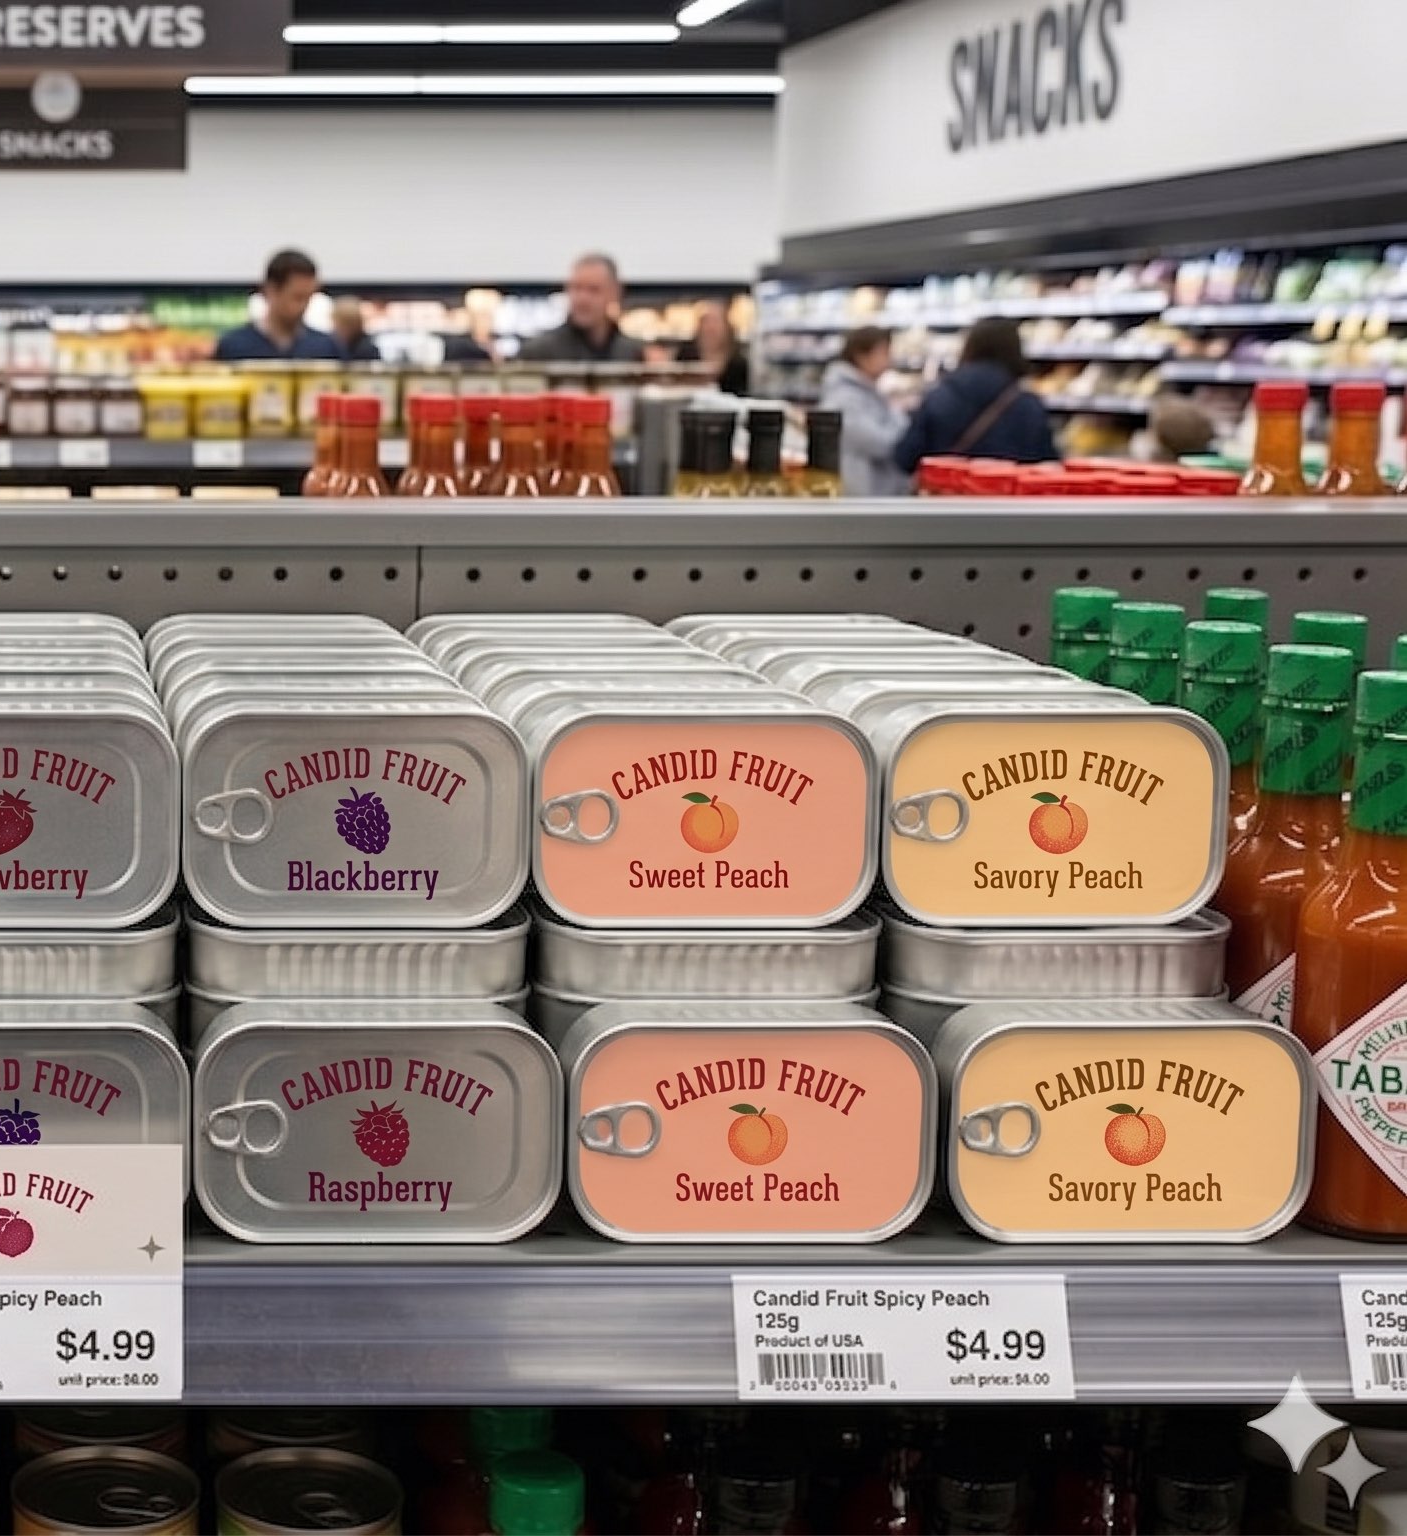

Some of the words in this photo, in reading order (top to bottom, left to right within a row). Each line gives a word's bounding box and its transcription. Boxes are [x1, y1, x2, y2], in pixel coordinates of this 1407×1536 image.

[947, 0, 1124, 153] SNACKS
[31, 750, 115, 803] FRUIT
[264, 748, 372, 801] CANDID
[382, 750, 466, 804] FRUIT
[611, 749, 718, 801] CANDID
[729, 751, 813, 805] FRUIT
[961, 749, 1068, 801] CANDID
[1079, 751, 1164, 805] FRUIT
[288, 861, 438, 900] Blackberry
[630, 861, 705, 888] Sweet
[715, 861, 788, 888] Peach
[974, 862, 1059, 897] Savory
[1069, 862, 1143, 888] Peach
[33, 1061, 121, 1115] FRUIT
[282, 1058, 392, 1110] CANDID
[405, 1060, 493, 1115] FRUIT
[656, 1057, 767, 1111] CANDID
[778, 1060, 865, 1115] FRUIT
[1036, 1057, 1145, 1111] CANDID
[1156, 1060, 1244, 1115] FRUIT
[1331, 1059, 1407, 1094] TAB
[26, 1174, 94, 1213] FRUIT
[309, 1172, 452, 1211] Raspberry
[676, 1173, 753, 1201] Sweet
[764, 1173, 839, 1201] Peach
[1049, 1173, 1136, 1210] Savory
[1146, 1173, 1222, 1201] Peach
[45, 1290, 101, 1306] Peach
[754, 1290, 819, 1306] Candid
[826, 1289, 868, 1306] Fruit
[874, 1290, 925, 1311] Spicy
[932, 1290, 989, 1306] Peach
[756, 1313, 799, 1333] 125g
[815, 1334, 828, 1347] of
[832, 1334, 863, 1347] USA
[1364, 1312, 1407, 1332] 125g
[56, 1328, 155, 1363] $4.99
[946, 1327, 1045, 1364] $4.99
